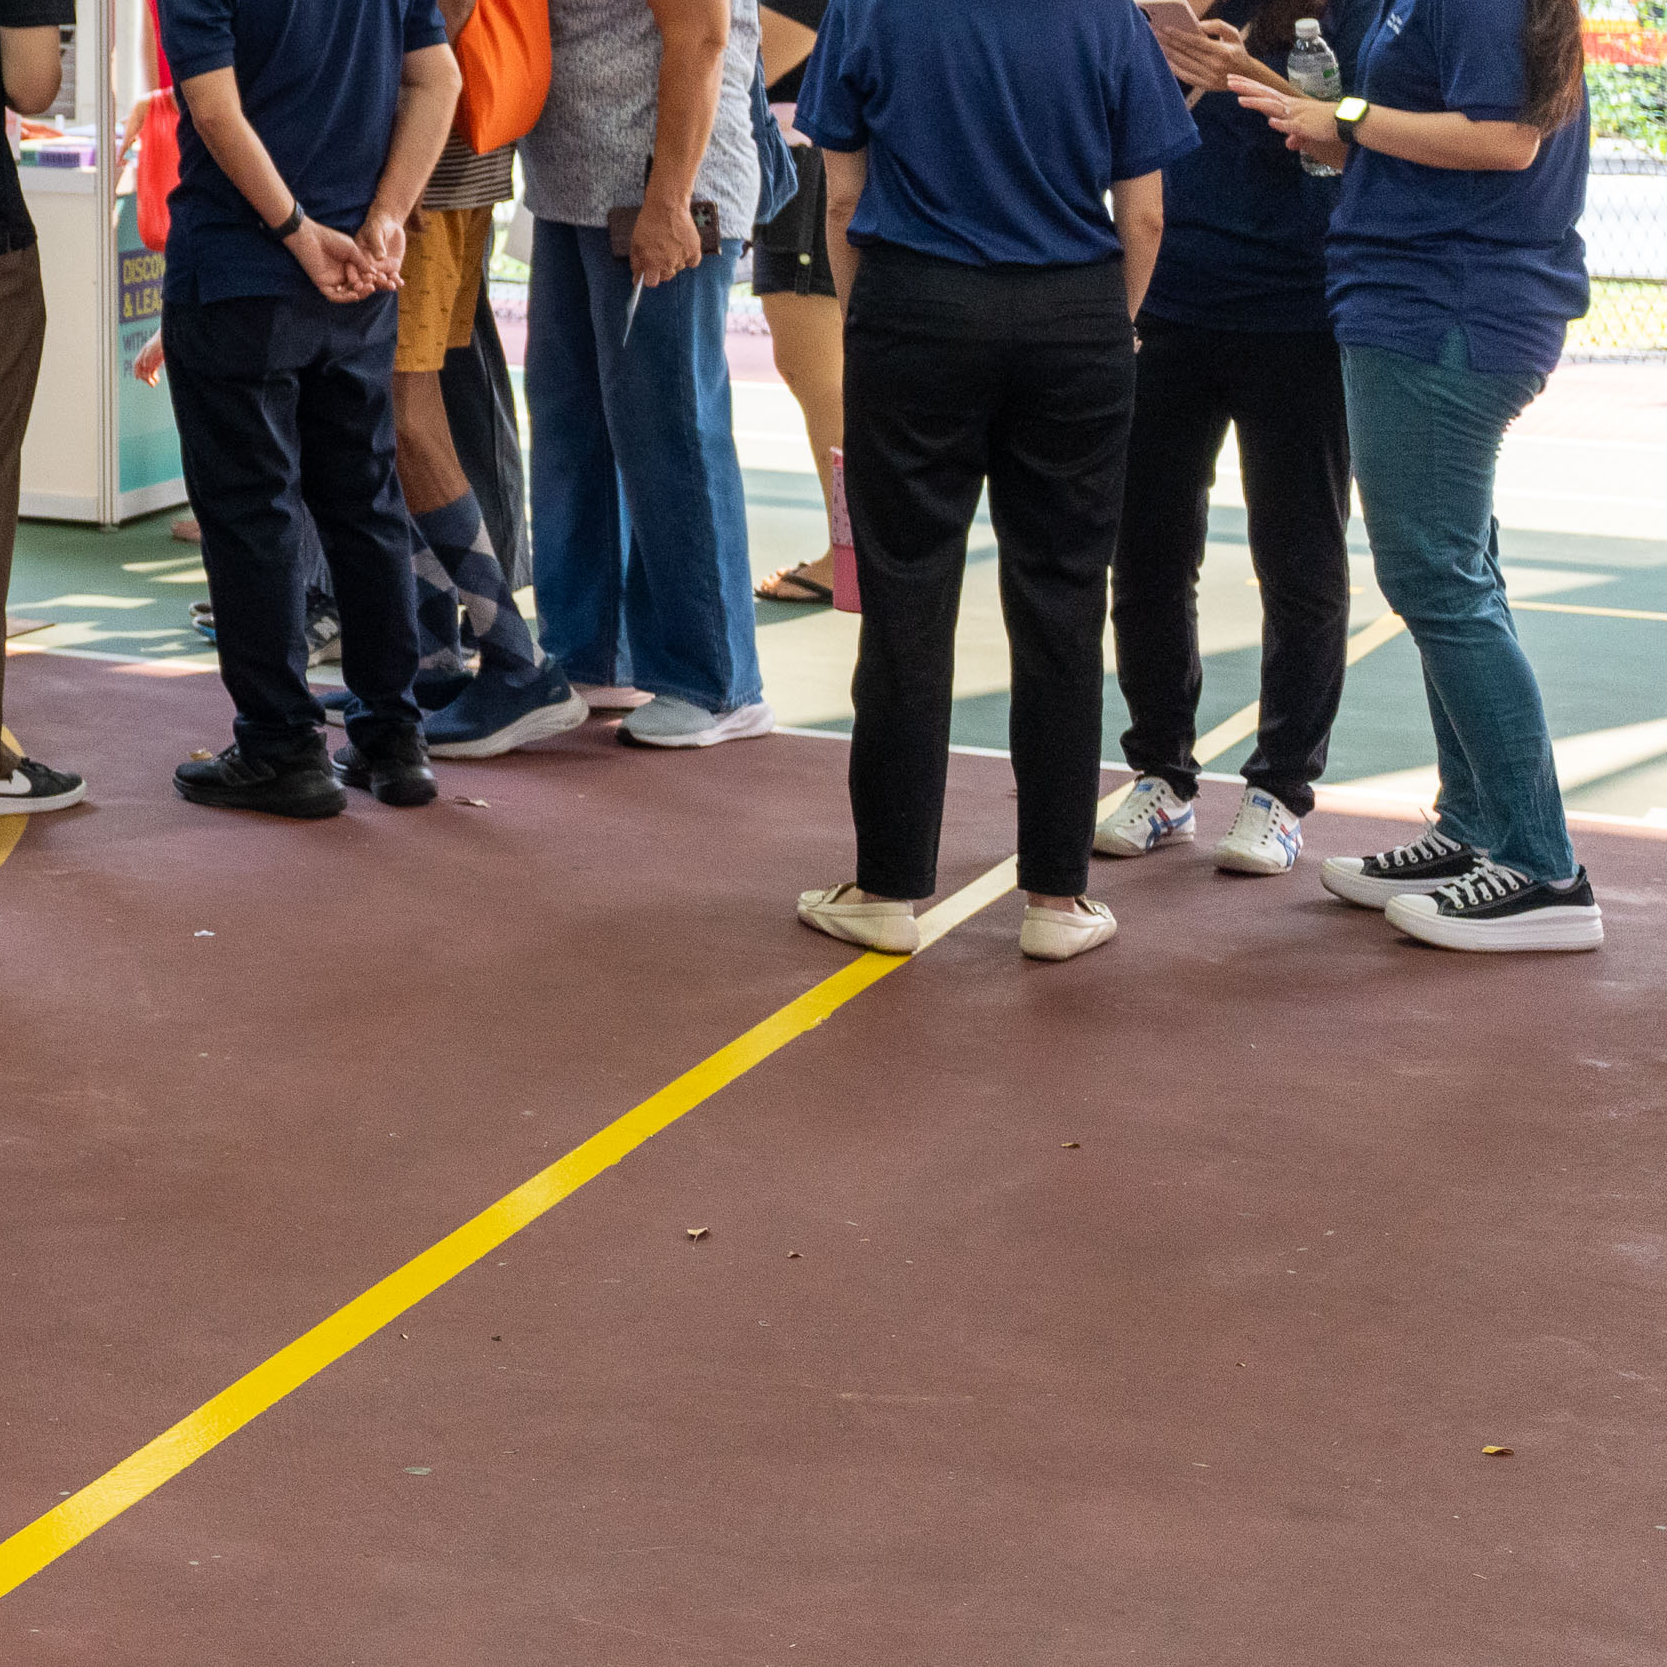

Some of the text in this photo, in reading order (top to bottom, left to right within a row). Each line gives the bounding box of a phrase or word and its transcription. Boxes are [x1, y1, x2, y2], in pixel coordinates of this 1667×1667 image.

[123, 252, 166, 286] DISCOV
[123, 287, 163, 318] & LEA
